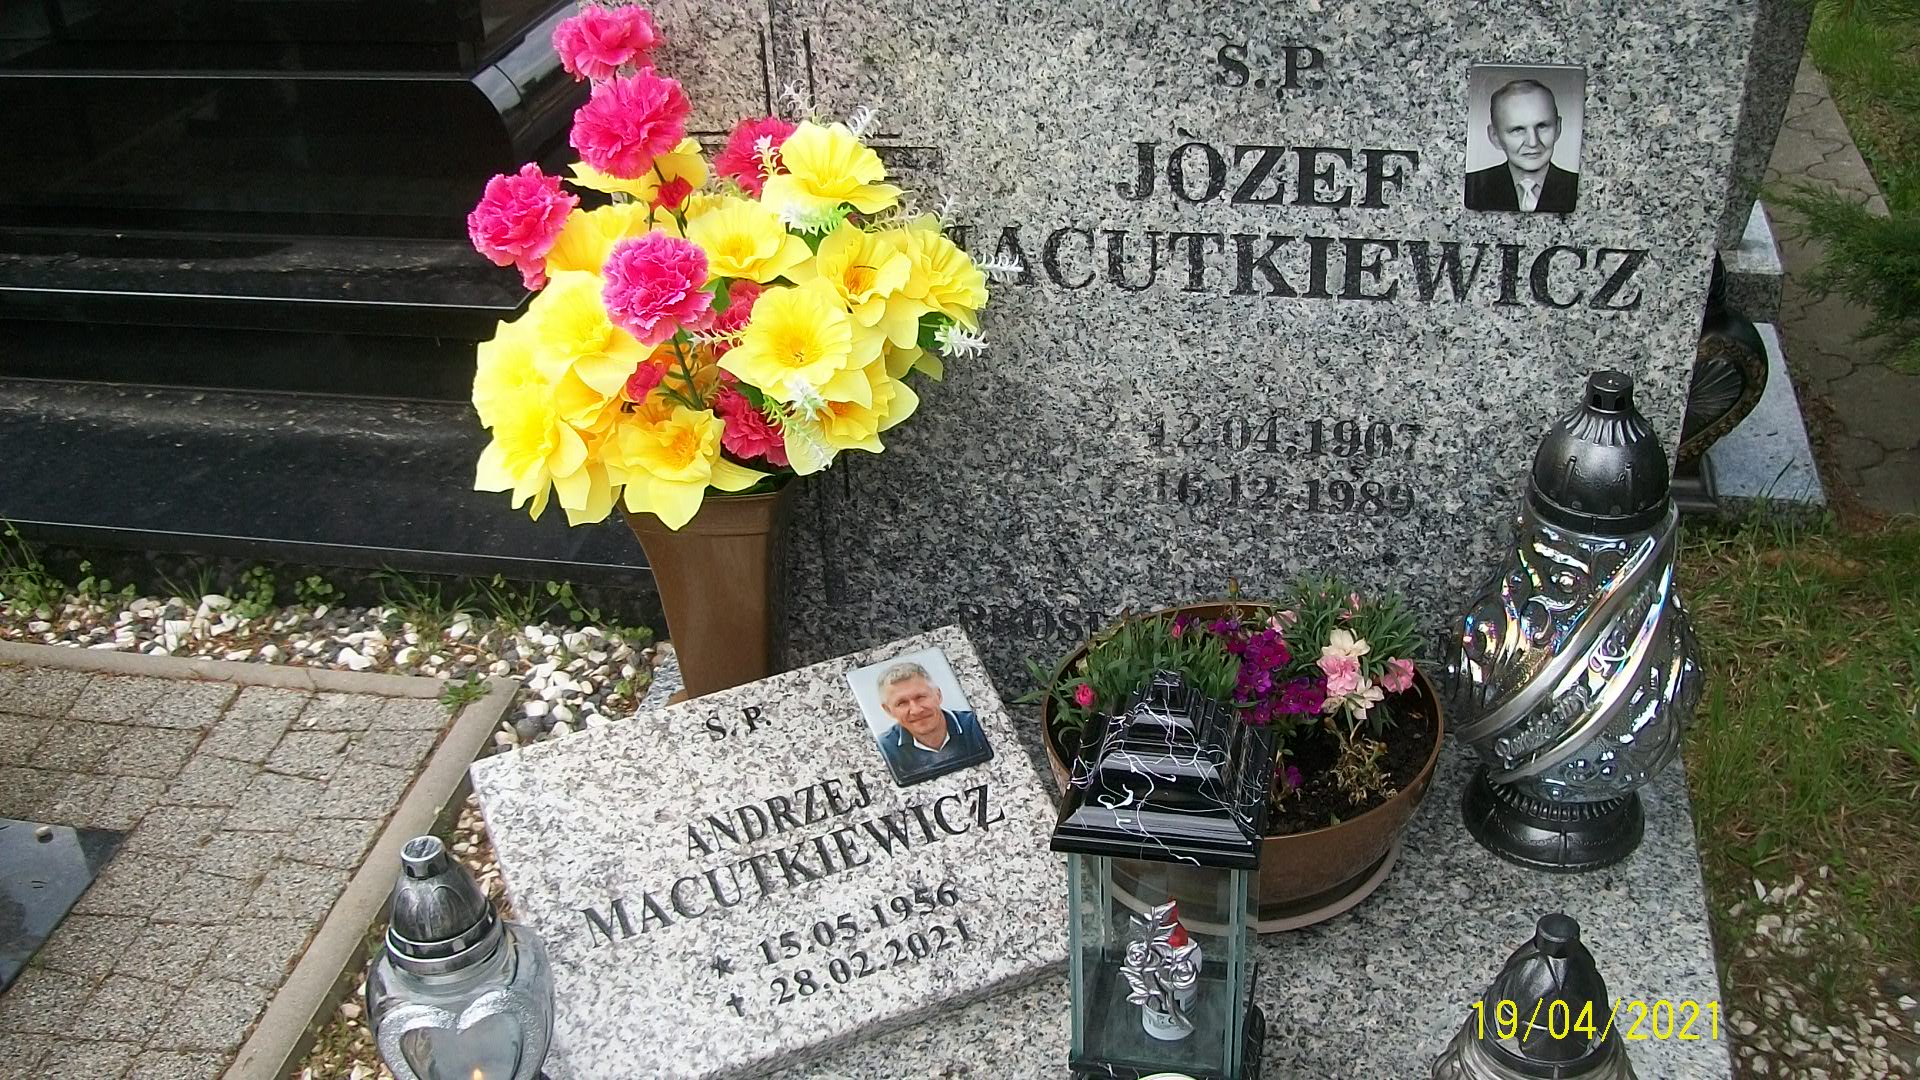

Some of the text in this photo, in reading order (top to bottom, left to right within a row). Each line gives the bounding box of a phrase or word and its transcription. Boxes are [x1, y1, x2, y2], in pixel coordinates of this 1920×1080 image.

[687, 771, 874, 861] ANDRZEJ
[580, 784, 1006, 949] MACUTKIEWICZ
[758, 878, 961, 966] 15.05.1956
[770, 917, 972, 1005] 28.02.2021
